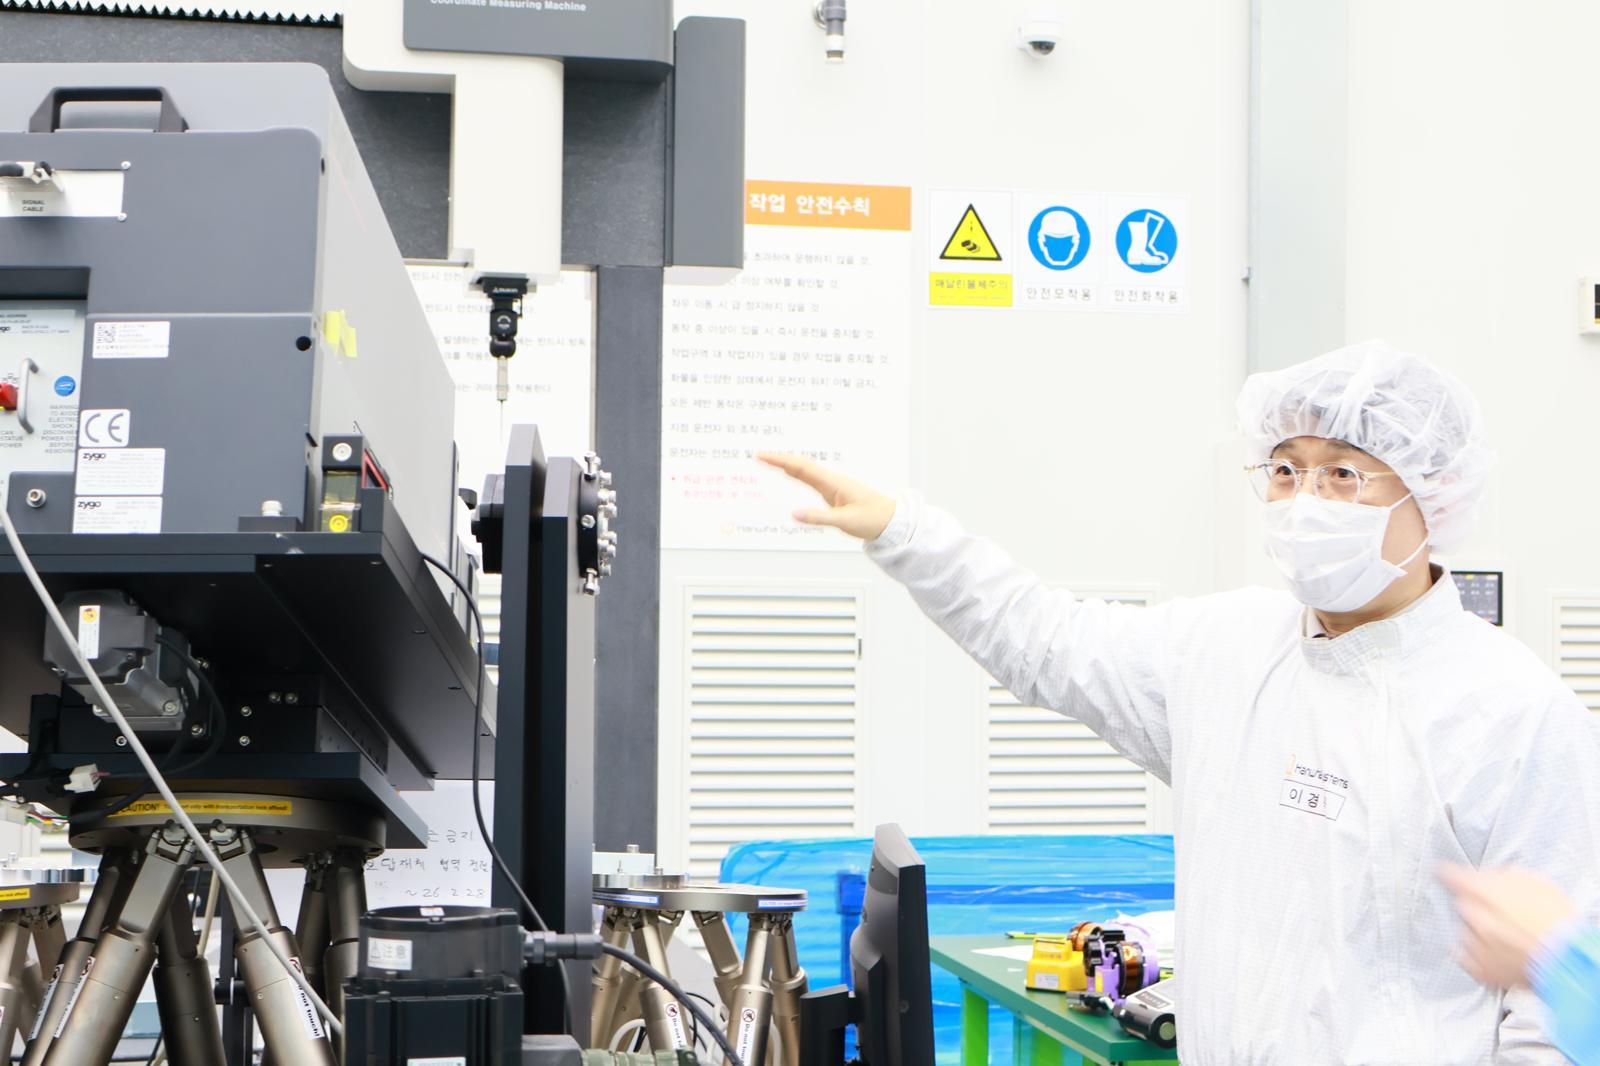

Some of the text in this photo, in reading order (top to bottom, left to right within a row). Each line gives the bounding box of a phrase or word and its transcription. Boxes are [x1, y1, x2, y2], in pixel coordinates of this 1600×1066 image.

[489, 0, 542, 10] Measuring
[544, 1, 587, 11] Machine
[748, 192, 871, 216] 작업 안전수칙
[85, 413, 124, 443] CE
[82, 452, 106, 461] zygo
[78, 500, 102, 510] zygo
[300, 993, 309, 1007] not
